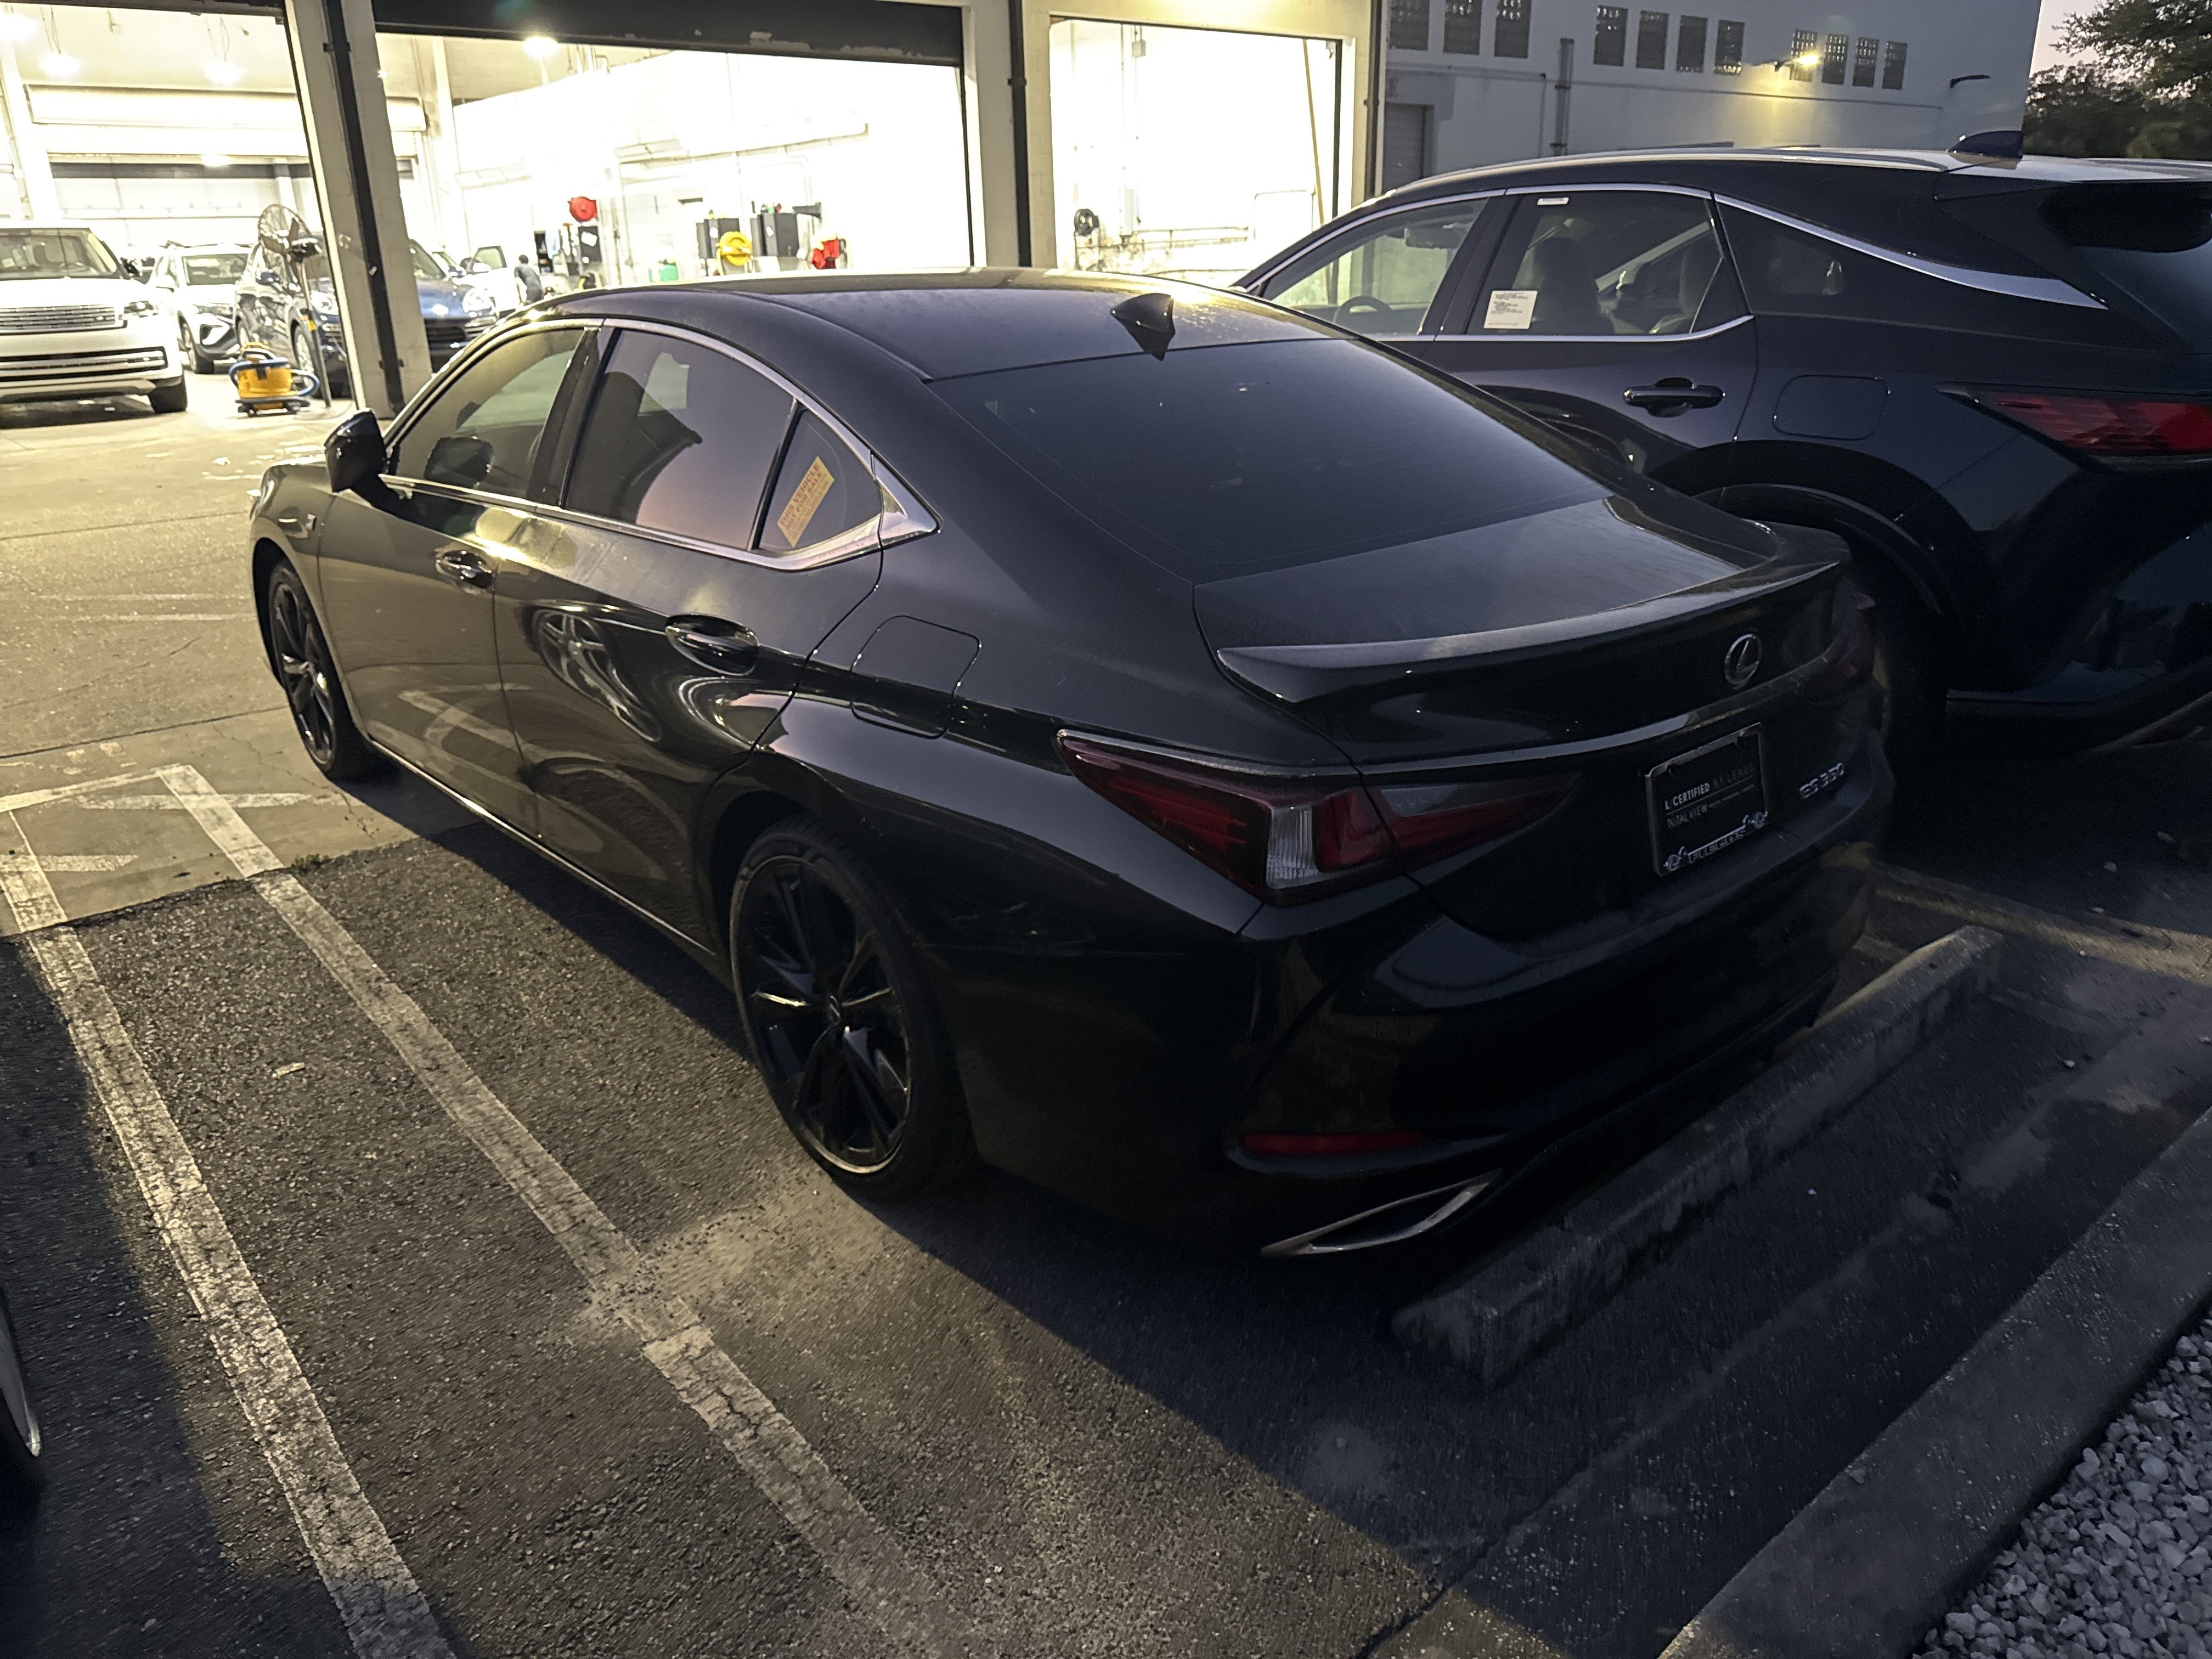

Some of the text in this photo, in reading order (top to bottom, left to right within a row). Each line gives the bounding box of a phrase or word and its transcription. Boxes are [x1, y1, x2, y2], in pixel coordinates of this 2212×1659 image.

[793, 464, 820, 503] VEHICLE
[795, 494, 808, 512] FOR
[807, 471, 822, 493] SALE
[1689, 828, 1746, 864] FIELDS
